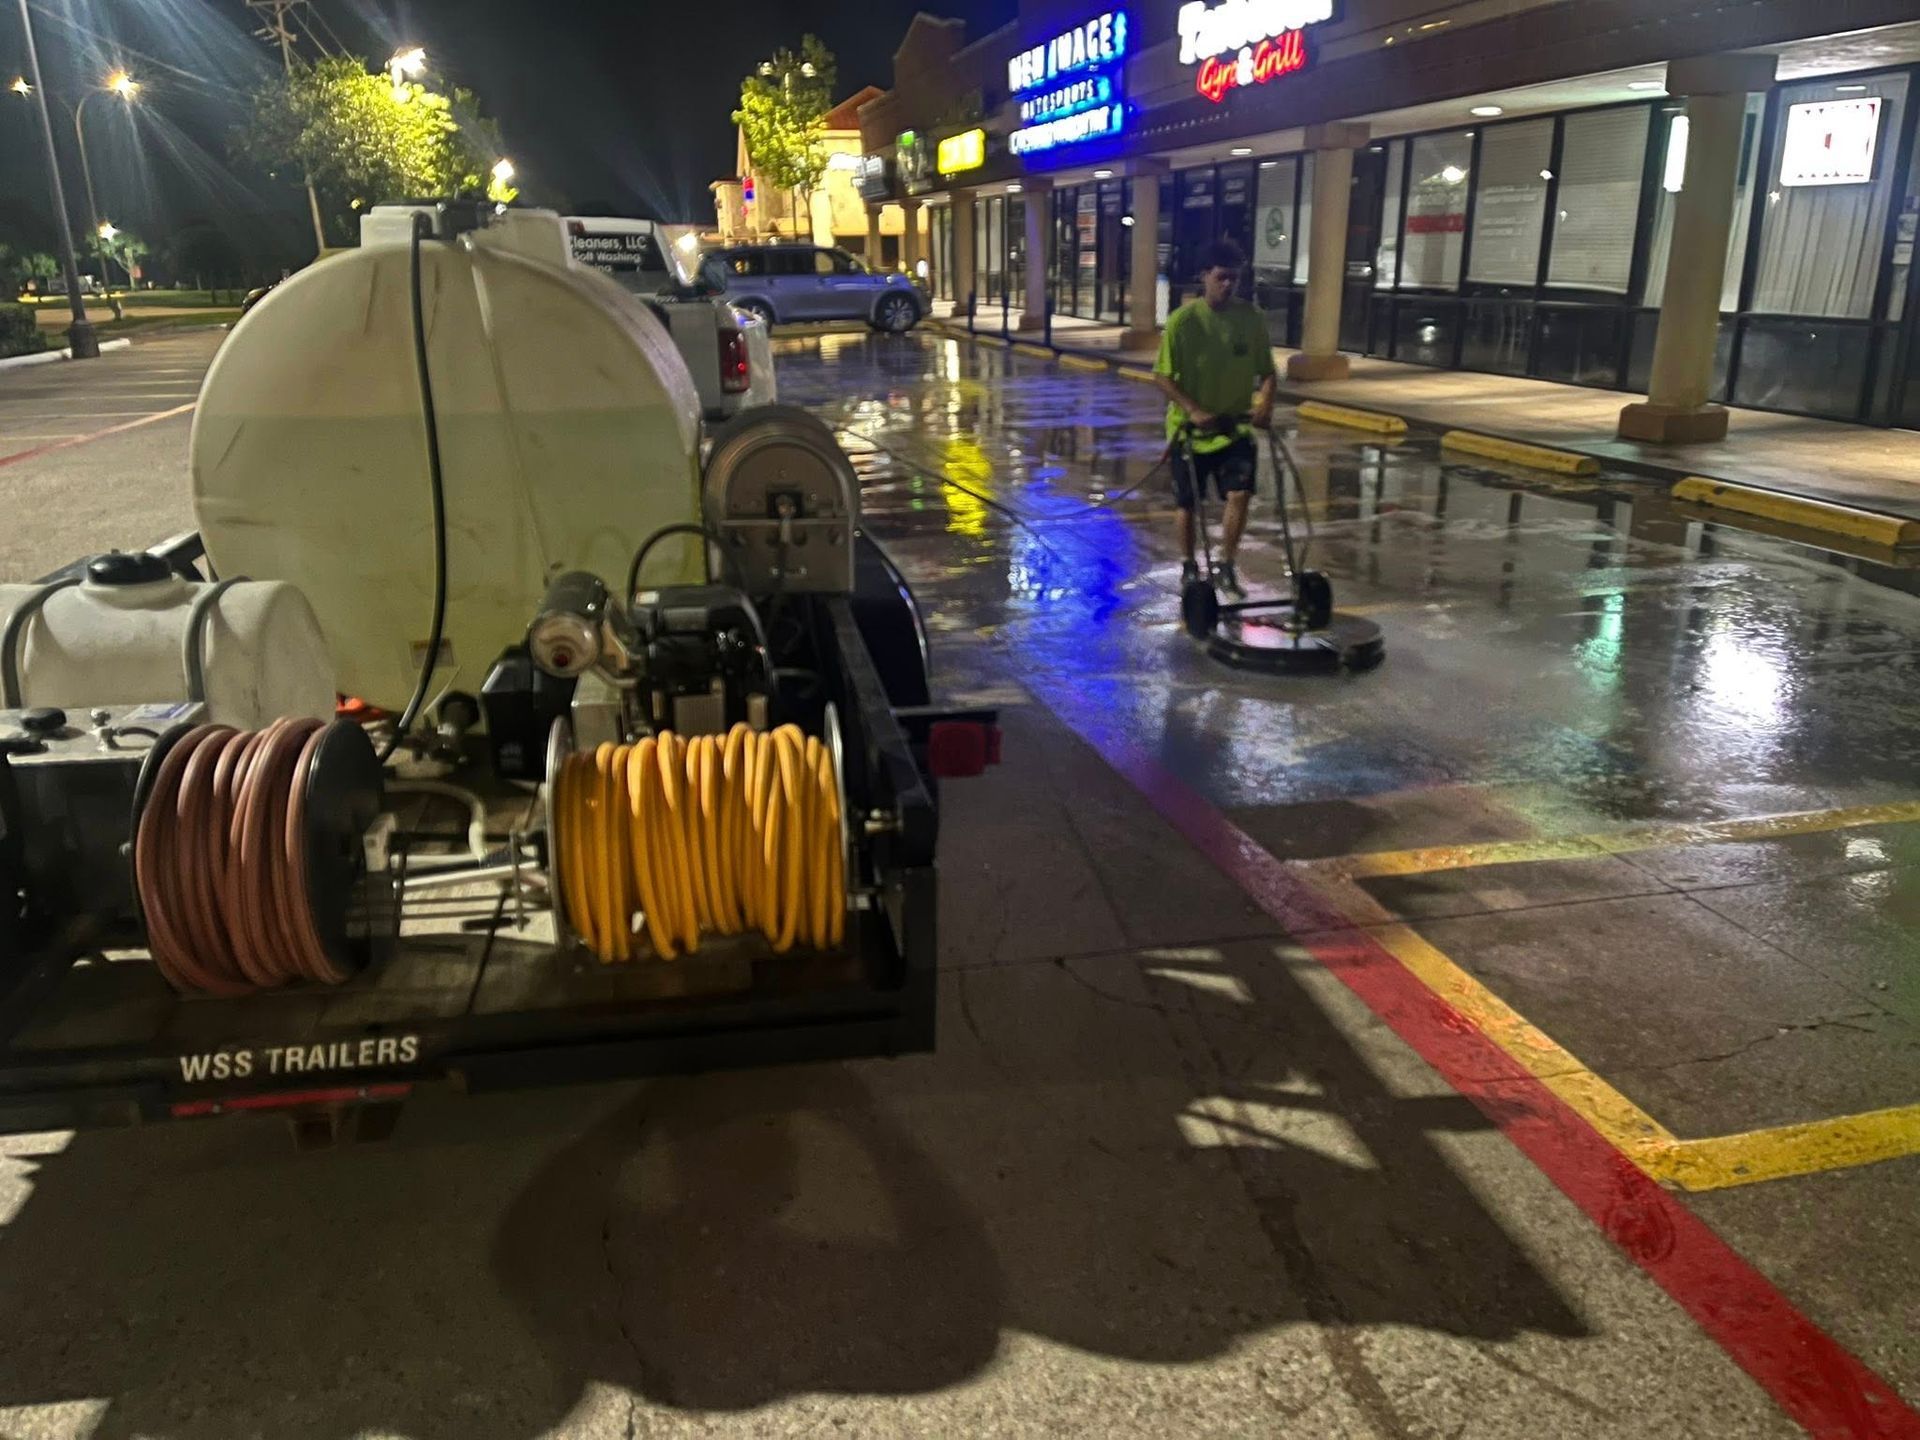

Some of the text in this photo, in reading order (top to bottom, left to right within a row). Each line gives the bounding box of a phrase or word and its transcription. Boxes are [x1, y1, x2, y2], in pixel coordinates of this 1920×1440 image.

[1047, 12, 1114, 78] IMAGE
[1253, 29, 1306, 83] Grill
[596, 251, 641, 264] Washing
[625, 235, 648, 249] LLC
[179, 1036, 420, 1083] WSS TRAILERS
